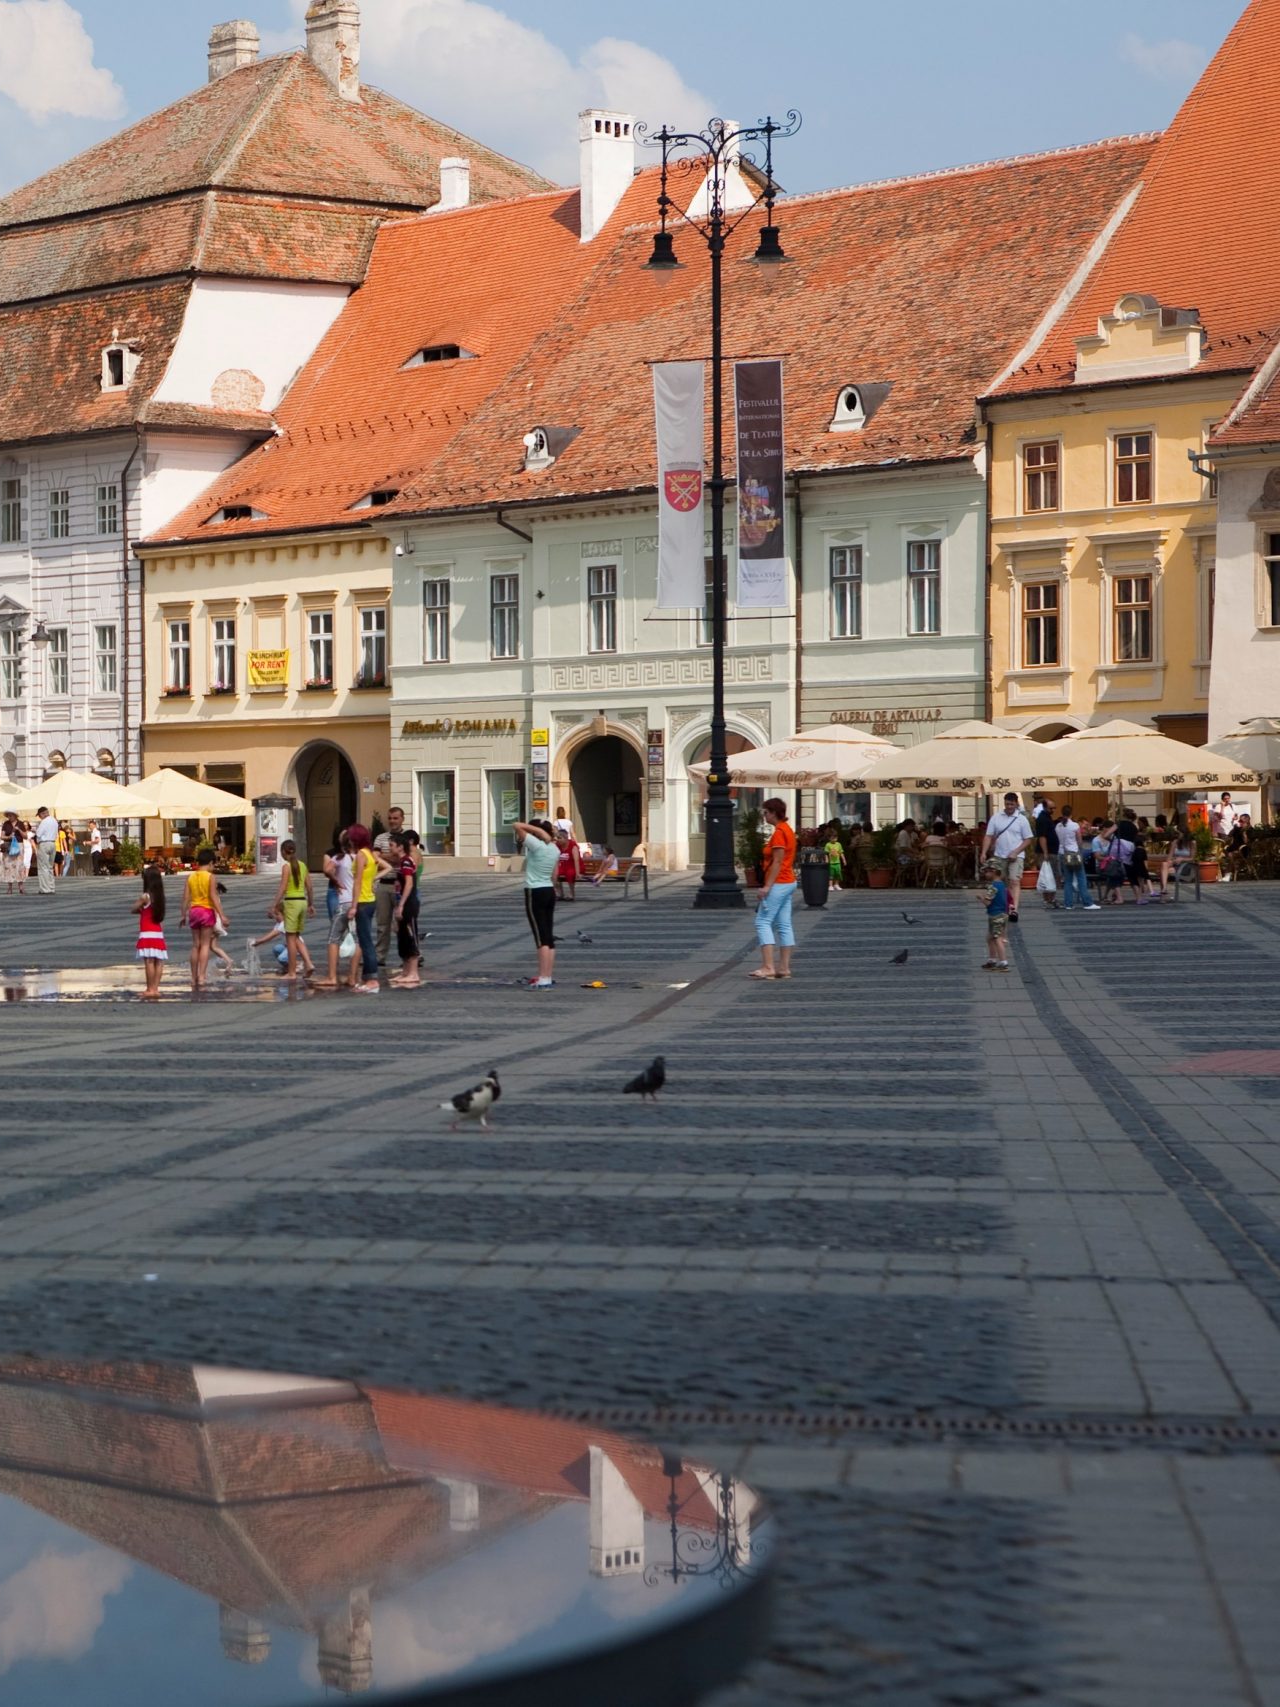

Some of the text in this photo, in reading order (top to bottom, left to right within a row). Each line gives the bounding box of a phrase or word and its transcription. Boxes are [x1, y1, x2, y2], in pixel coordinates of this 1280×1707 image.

[738, 399, 781, 408] FESTIVALUL
[740, 430, 781, 439] DE TEATRU
[740, 450, 750, 458] DE
[251, 660, 286, 669] FOR RENT
[830, 711, 871, 723] GALERIA
[874, 710, 887, 722] DE
[456, 718, 516, 732] ROMANIA
[843, 778, 975, 790] URSUS URSUS URSUS URSUS
[989, 776, 1113, 789] URSUS URSUS URSUS URSUS
[1128, 776, 1150, 788] URSUS
[1162, 774, 1185, 785] URSUS
[1197, 772, 1219, 784] URSUS
[1231, 772, 1254, 784] URSUS
